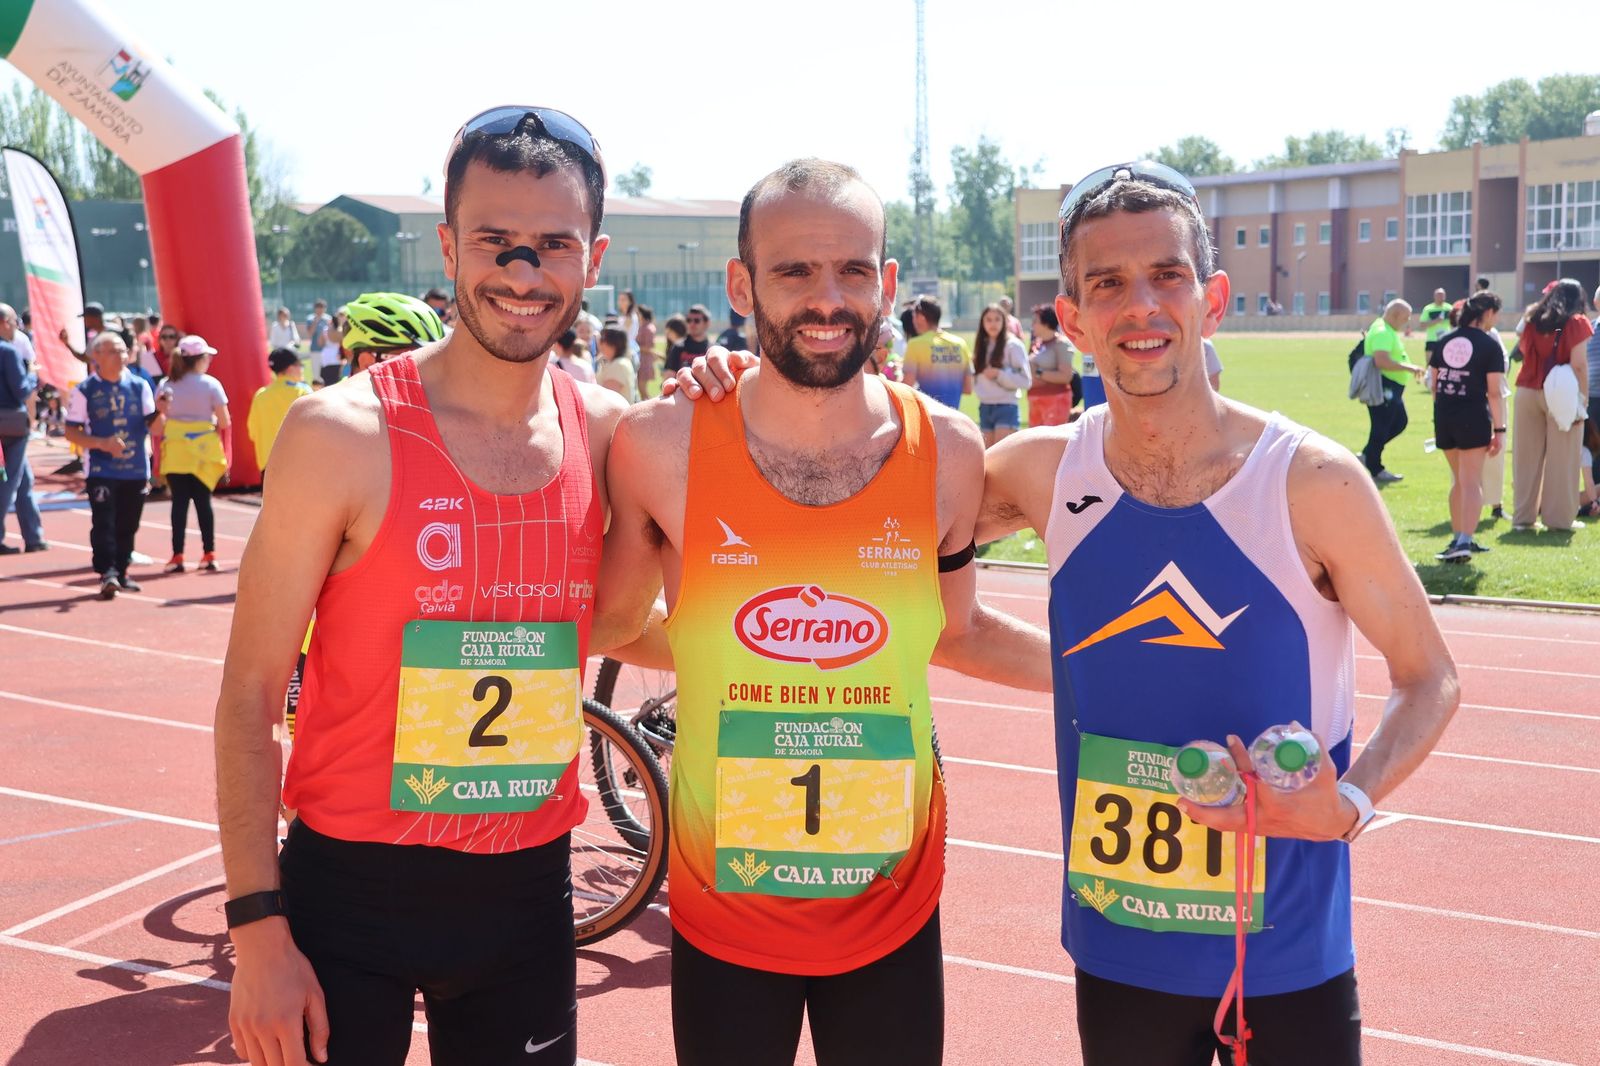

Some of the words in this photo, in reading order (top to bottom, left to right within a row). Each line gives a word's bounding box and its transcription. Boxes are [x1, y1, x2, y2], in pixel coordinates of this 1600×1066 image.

[46, 68, 65, 88] DE
[69, 90, 131, 144] ZAMORA
[57, 60, 143, 135] AYUNTAMIENTO
[110, 395, 125, 411] 17
[419, 498, 464, 510] 42K
[711, 552, 758, 565] rasán
[858, 546, 921, 560] SERRANO
[881, 562, 918, 570] ATLETISMO
[415, 579, 464, 603] ada
[481, 580, 561, 598] vistasol
[750, 606, 875, 643] Serrano
[461, 644, 495, 657] CAJA
[498, 644, 545, 657] RURAL
[460, 658, 472, 666] DE
[474, 658, 507, 666] ZAMORA
[729, 683, 773, 703] COME
[780, 685, 819, 704] BIEN
[826, 687, 836, 704] Y
[843, 686, 891, 704] CORRE
[468, 675, 513, 747] 2
[774, 734, 809, 747] CAJA
[814, 734, 863, 747] RURAL
[789, 748, 823, 756] ZAMORA
[1127, 763, 1160, 779] CAJA
[453, 780, 502, 800] CAJA
[508, 778, 561, 797] RURA
[790, 764, 821, 836] 1
[1090, 793, 1222, 877] 381
[773, 865, 825, 884] CAJA
[831, 867, 876, 884] RUR
[1121, 895, 1170, 919] CAJA
